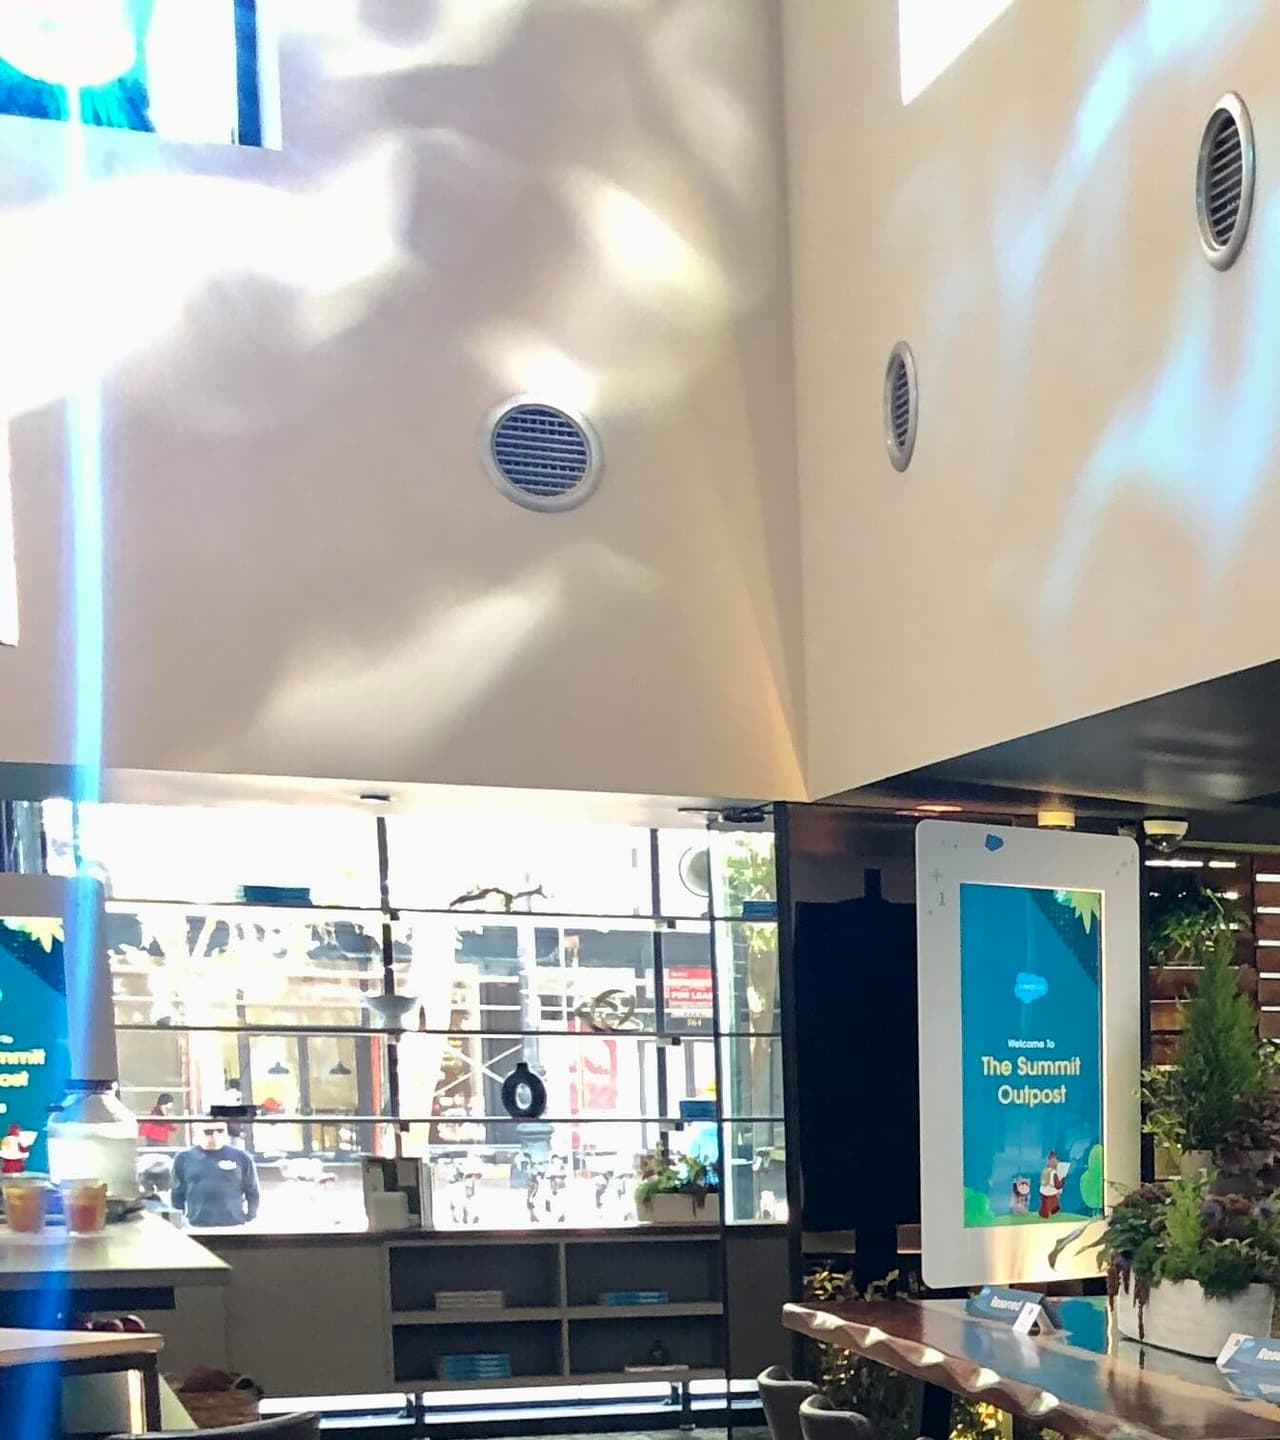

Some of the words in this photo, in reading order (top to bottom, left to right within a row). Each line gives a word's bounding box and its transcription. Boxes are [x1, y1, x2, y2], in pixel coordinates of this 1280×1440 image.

[1008, 1039, 1045, 1049] Welcome
[1046, 1039, 1055, 1049] To
[981, 1056, 1012, 1076] The
[1017, 1056, 1081, 1076] Summit
[998, 1084, 1067, 1108] Outpost
[990, 1295, 1023, 1311] Reserved
